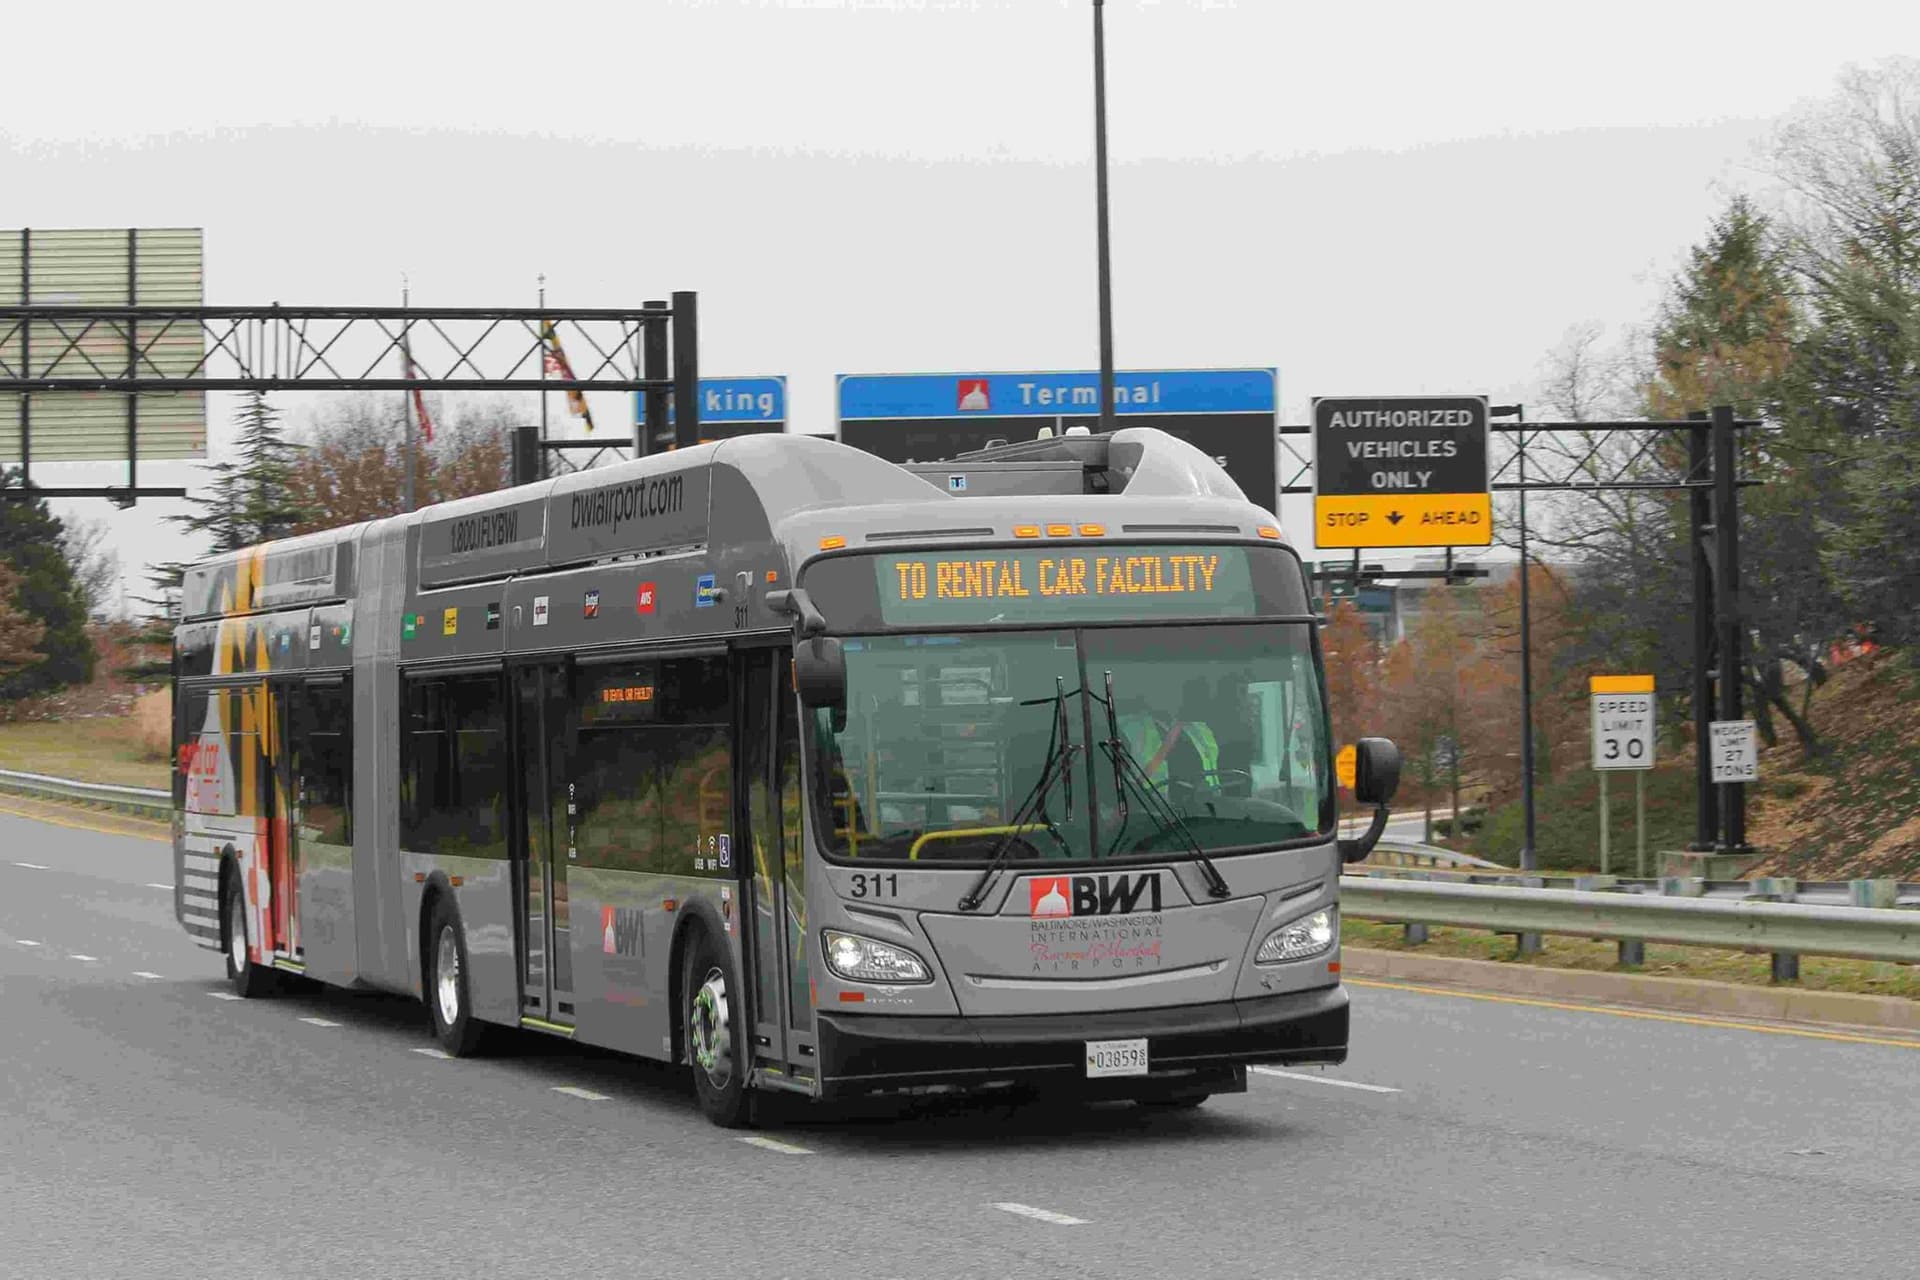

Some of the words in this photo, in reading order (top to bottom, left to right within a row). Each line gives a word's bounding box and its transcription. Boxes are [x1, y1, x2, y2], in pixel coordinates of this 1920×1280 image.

[1018, 382, 1160, 405] Termnal
[706, 389, 774, 417] king
[1329, 409, 1473, 428] AUTHORIZED
[1347, 440, 1457, 458] VEHICLES
[1371, 471, 1432, 488] ONLY
[571, 475, 683, 536] bwiairport.com
[1326, 512, 1369, 527] STOP
[1421, 511, 1480, 525] AHEAD
[895, 562, 927, 599] TO
[937, 560, 1030, 598] RENTAL
[1039, 558, 1087, 595] CAR
[1095, 555, 1218, 594] FACILITY
[640, 591, 652, 606] AVIS
[734, 605, 748, 628] 311
[1598, 701, 1649, 713] SPEED
[1602, 719, 1645, 731] LIMIT
[1604, 738, 1644, 760] 30
[1725, 750, 1743, 761] 27
[1715, 764, 1753, 776] TONS
[850, 874, 898, 898] 311
[1072, 873, 1162, 916] BWI
[1031, 915, 1162, 931] BALTIMORE/WASHINGTON
[1031, 928, 1162, 943] INTERNATIONAL
[1033, 955, 1162, 972] AIRPORT
[1096, 1049, 1138, 1068] 03859
